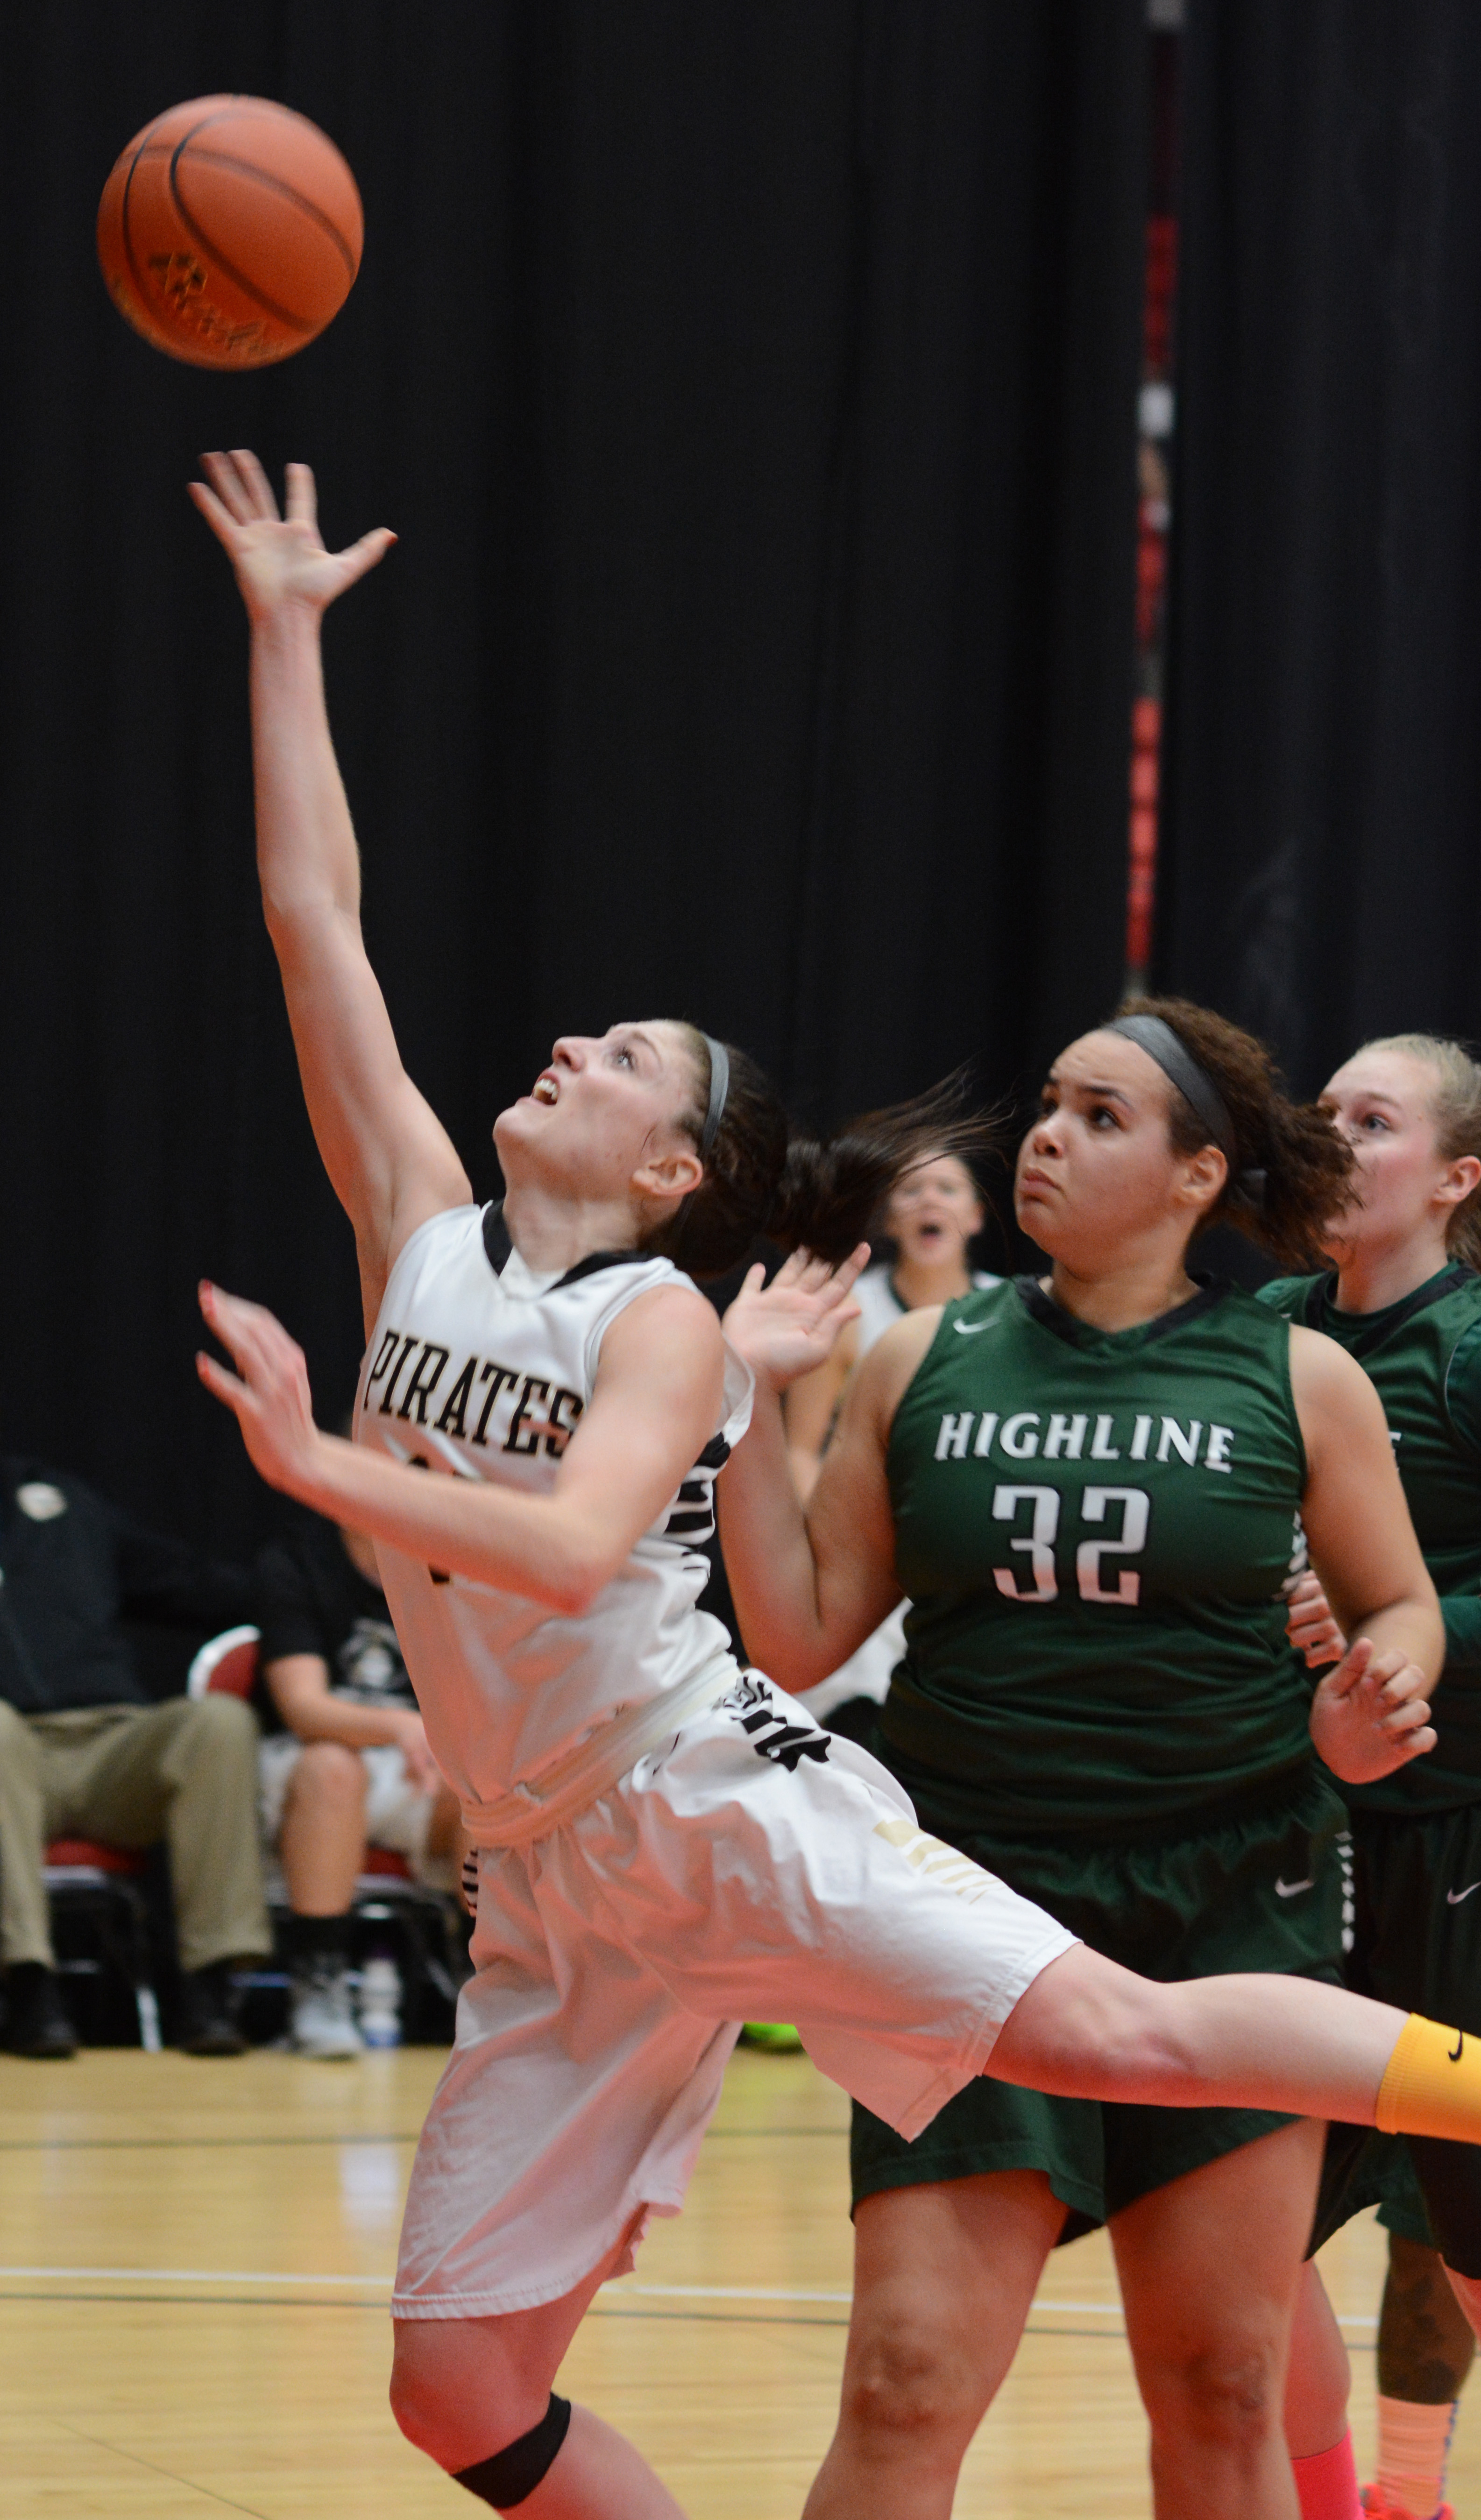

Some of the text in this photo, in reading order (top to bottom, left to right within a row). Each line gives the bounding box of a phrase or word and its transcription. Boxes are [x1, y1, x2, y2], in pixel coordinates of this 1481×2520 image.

[363, 1329, 585, 1459] PIRATES
[934, 1411, 1235, 1474] HIGHLINE
[991, 1484, 1150, 1606] 32
